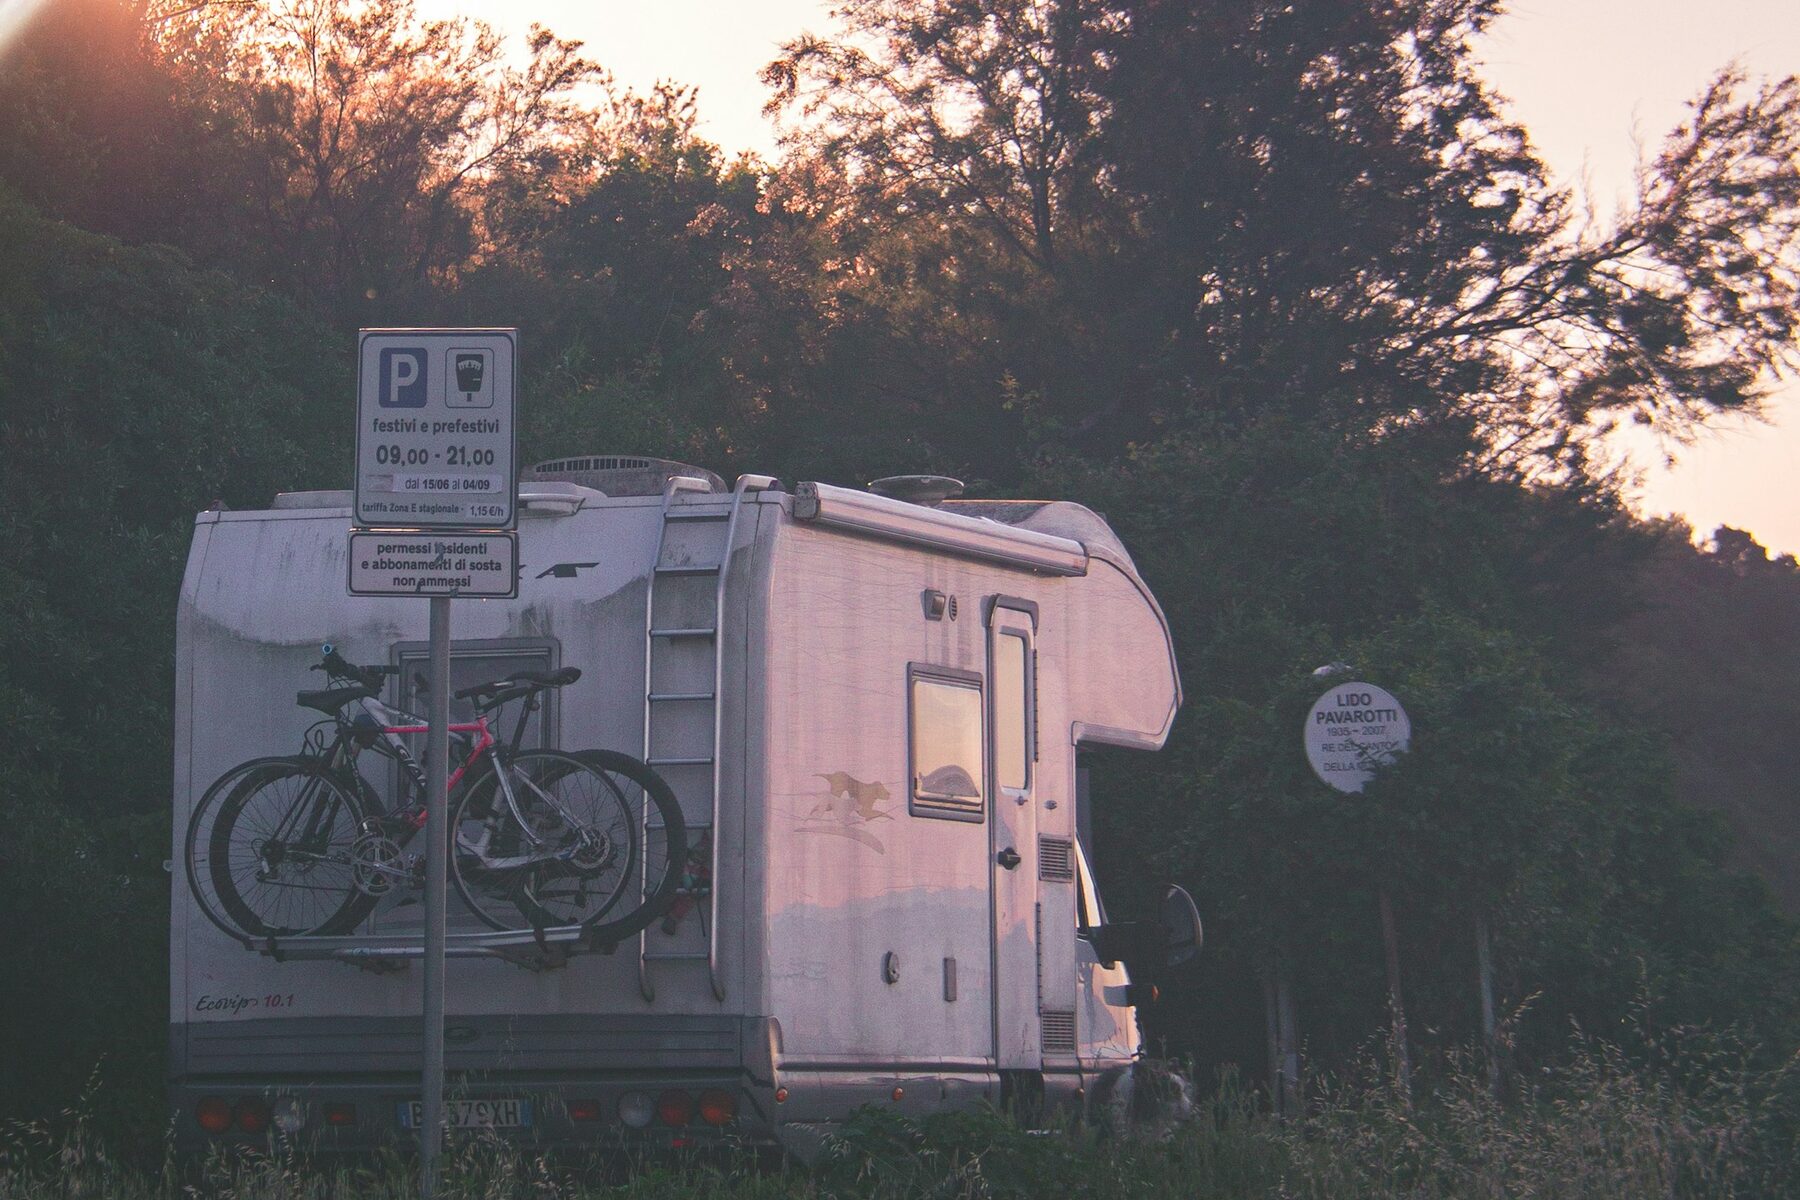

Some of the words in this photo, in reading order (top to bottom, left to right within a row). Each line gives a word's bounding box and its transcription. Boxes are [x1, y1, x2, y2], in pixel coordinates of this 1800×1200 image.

[390, 354, 418, 401] P
[373, 418, 416, 432] festivi
[421, 422, 429, 432] e
[433, 418, 499, 435] prefestivi
[376, 445, 429, 467] 09,00
[446, 445, 494, 467] 21,00
[405, 478, 419, 489] dal
[422, 479, 449, 489] 15/06
[452, 478, 460, 489] al
[463, 479, 490, 490] 04/09
[362, 503, 387, 513] tariffa
[389, 503, 409, 513] Zona
[411, 503, 417, 513] E
[419, 503, 459, 515] stagionale
[377, 543, 431, 555] permessi
[361, 560, 369, 570] e
[372, 559, 451, 570] abbonamenti
[455, 559, 466, 570] di
[469, 560, 502, 571] sosta
[393, 577, 416, 587] non
[420, 576, 471, 587] ammessi
[1337, 693, 1371, 707] LIDO
[1316, 709, 1397, 724] PAVAROTTI
[1327, 726, 1350, 736] 1935
[1362, 725, 1385, 736] 2007
[1322, 743, 1335, 752] RE
[264, 994, 294, 1008] 10.1
